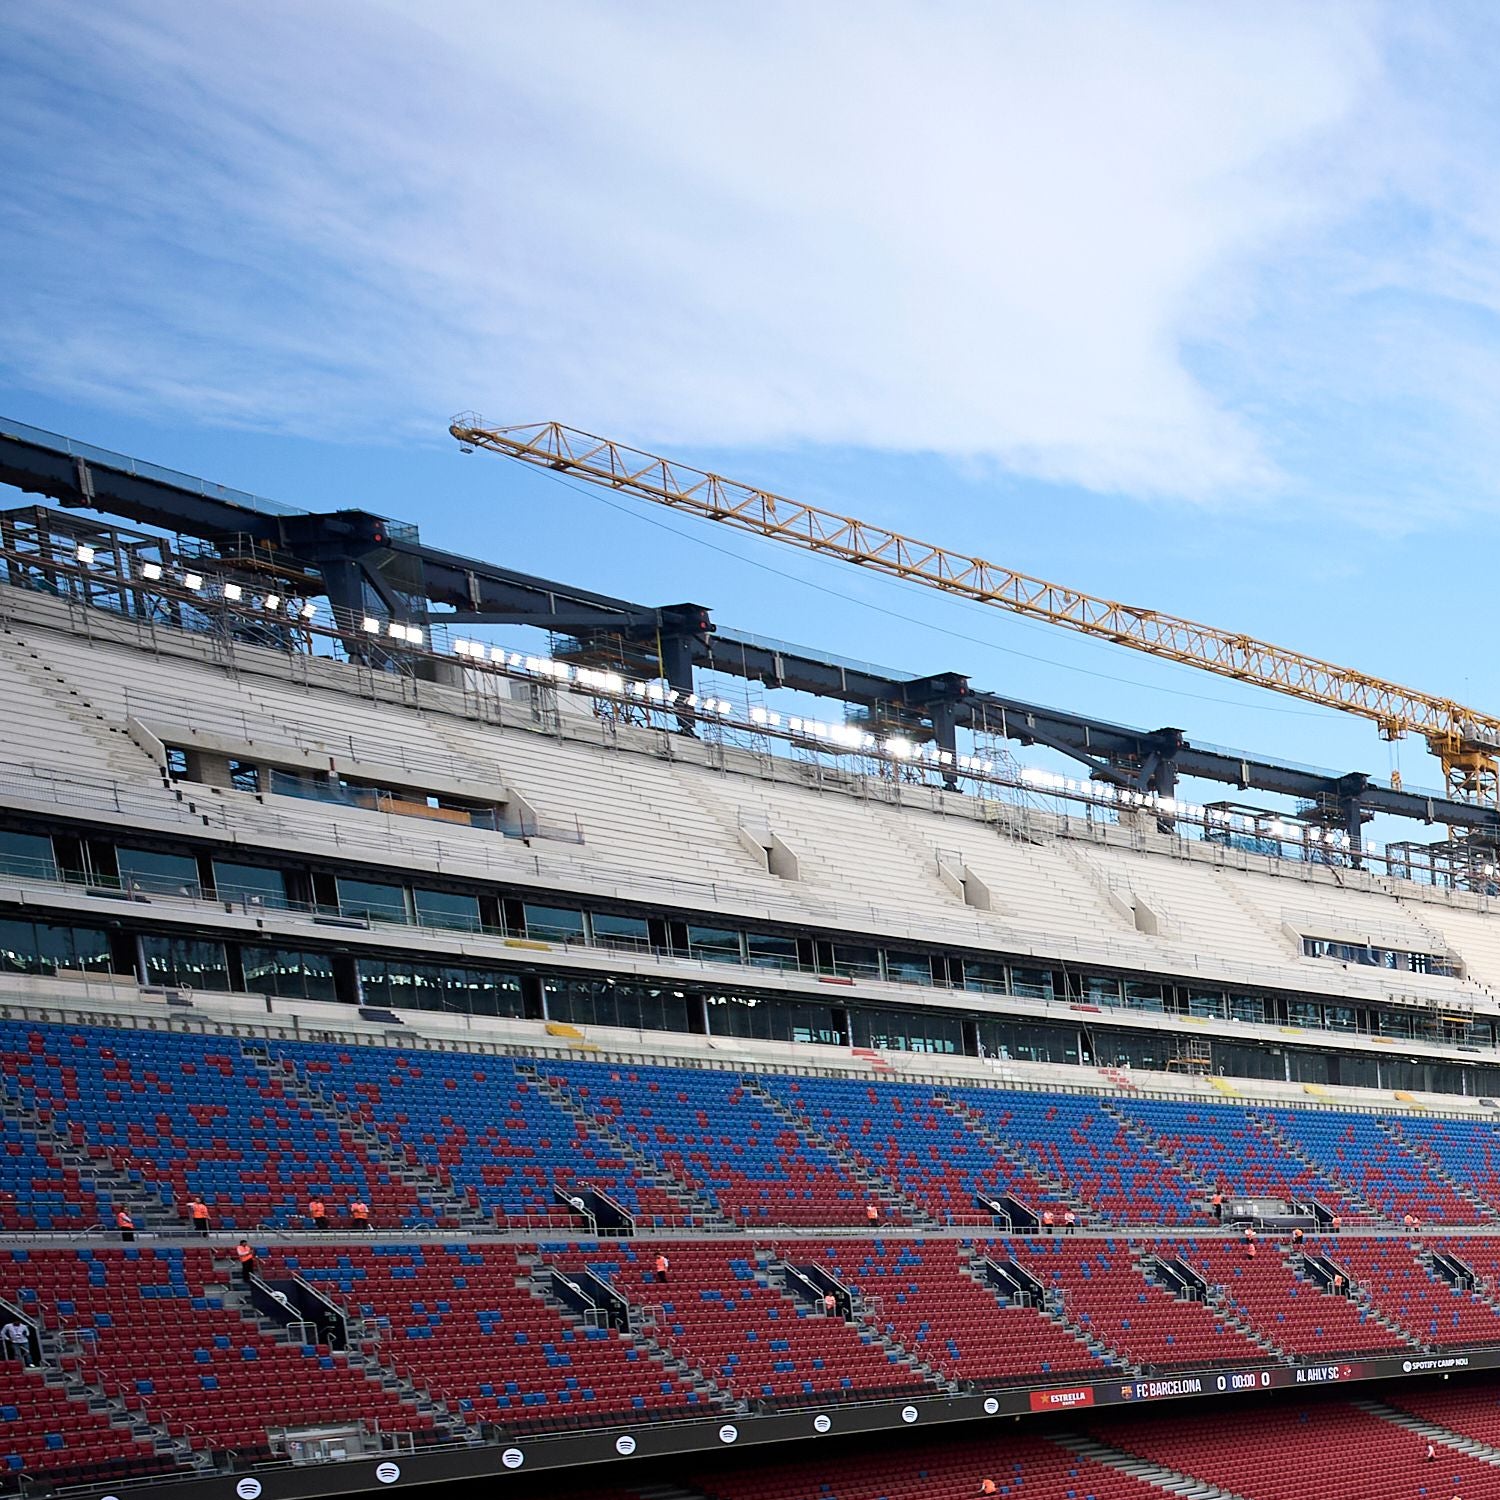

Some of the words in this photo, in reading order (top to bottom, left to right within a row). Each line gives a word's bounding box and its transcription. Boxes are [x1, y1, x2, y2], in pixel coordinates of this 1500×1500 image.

[1412, 1360, 1438, 1370] SPOTIFY
[1437, 1358, 1456, 1368] CAMP
[1455, 1358, 1469, 1367] NOU
[1136, 1383, 1149, 1398] FC
[1150, 1379, 1201, 1397] BARCELONA
[1216, 1375, 1227, 1391] 0
[1232, 1374, 1255, 1388] 00:00
[1261, 1371, 1270, 1387] 0
[1296, 1369, 1307, 1382] AL
[1307, 1367, 1328, 1382] AHLY
[1328, 1366, 1339, 1380] SC
[1050, 1391, 1086, 1403] ESTRELLA
